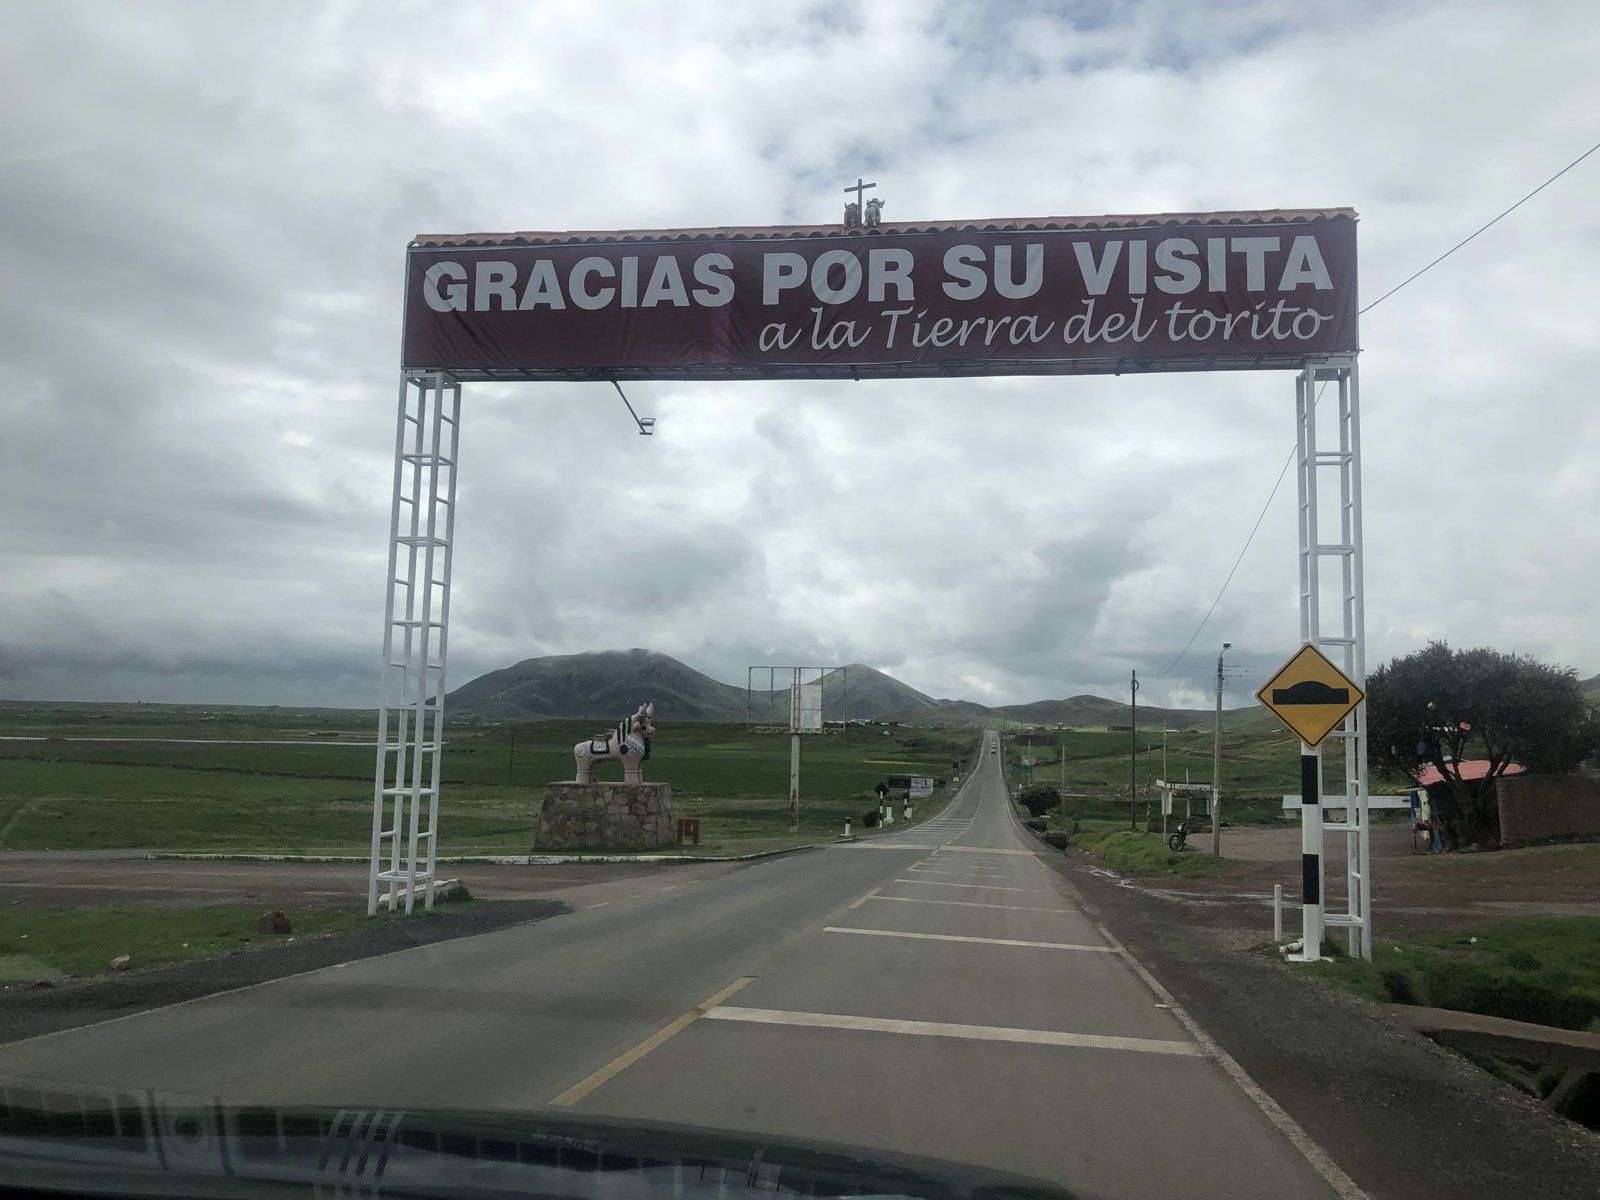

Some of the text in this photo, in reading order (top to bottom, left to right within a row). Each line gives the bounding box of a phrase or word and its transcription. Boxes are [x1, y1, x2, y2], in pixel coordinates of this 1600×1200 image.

[423, 235, 1334, 312] GRACIAS POR SU VISITA
[758, 297, 1335, 351] a la Tierra del torito
